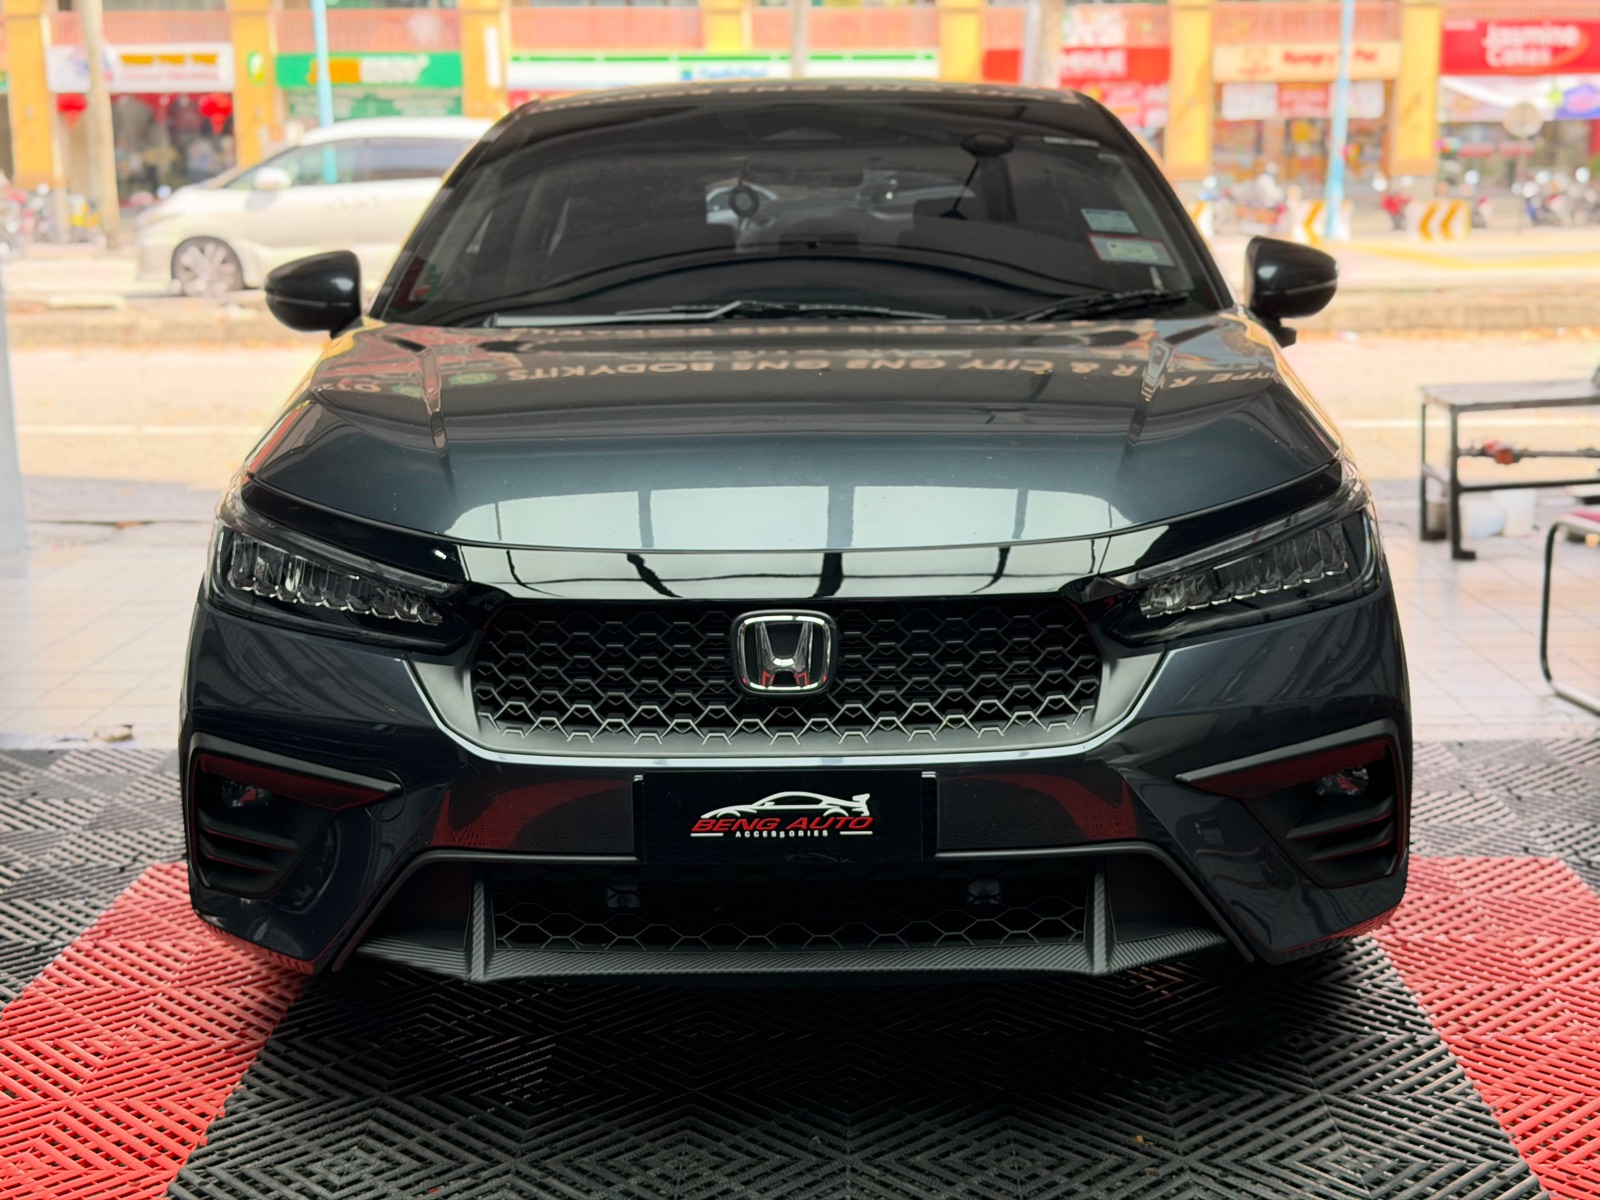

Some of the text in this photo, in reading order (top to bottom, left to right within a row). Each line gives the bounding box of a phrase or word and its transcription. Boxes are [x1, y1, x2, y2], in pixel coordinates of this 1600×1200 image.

[506, 361, 714, 382] BODYKITS
[691, 816, 873, 832] BENG AUTO
[735, 829, 829, 839] ACCESSORIES
